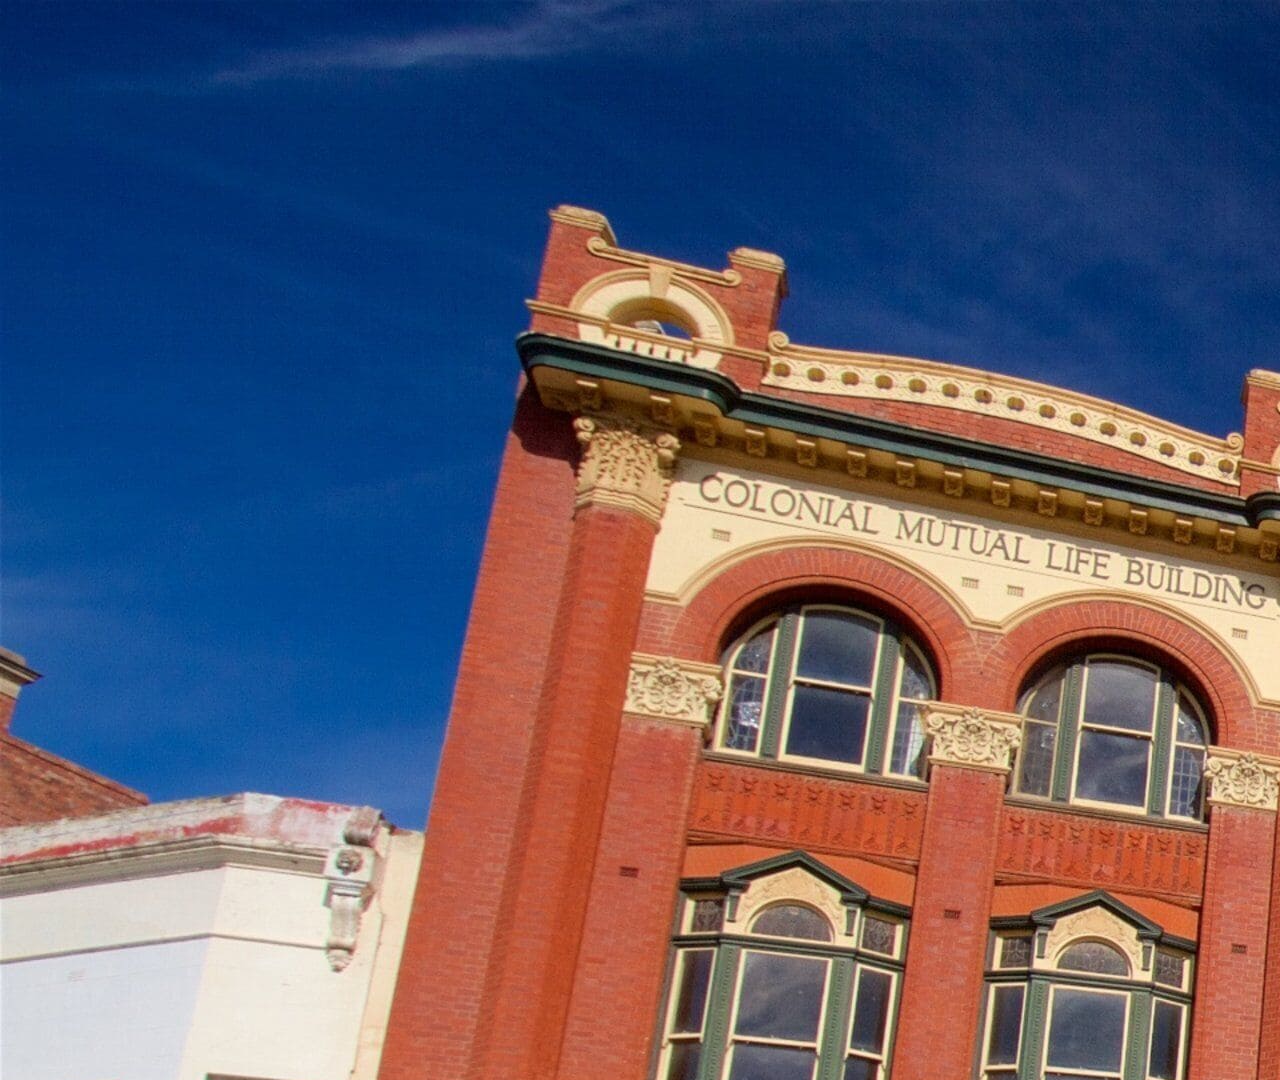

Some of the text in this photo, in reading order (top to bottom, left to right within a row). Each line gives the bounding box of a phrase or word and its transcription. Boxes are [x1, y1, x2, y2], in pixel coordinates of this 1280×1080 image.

[699, 474, 1267, 610] COLONIAL MUTUAL LIFE BUILDING
